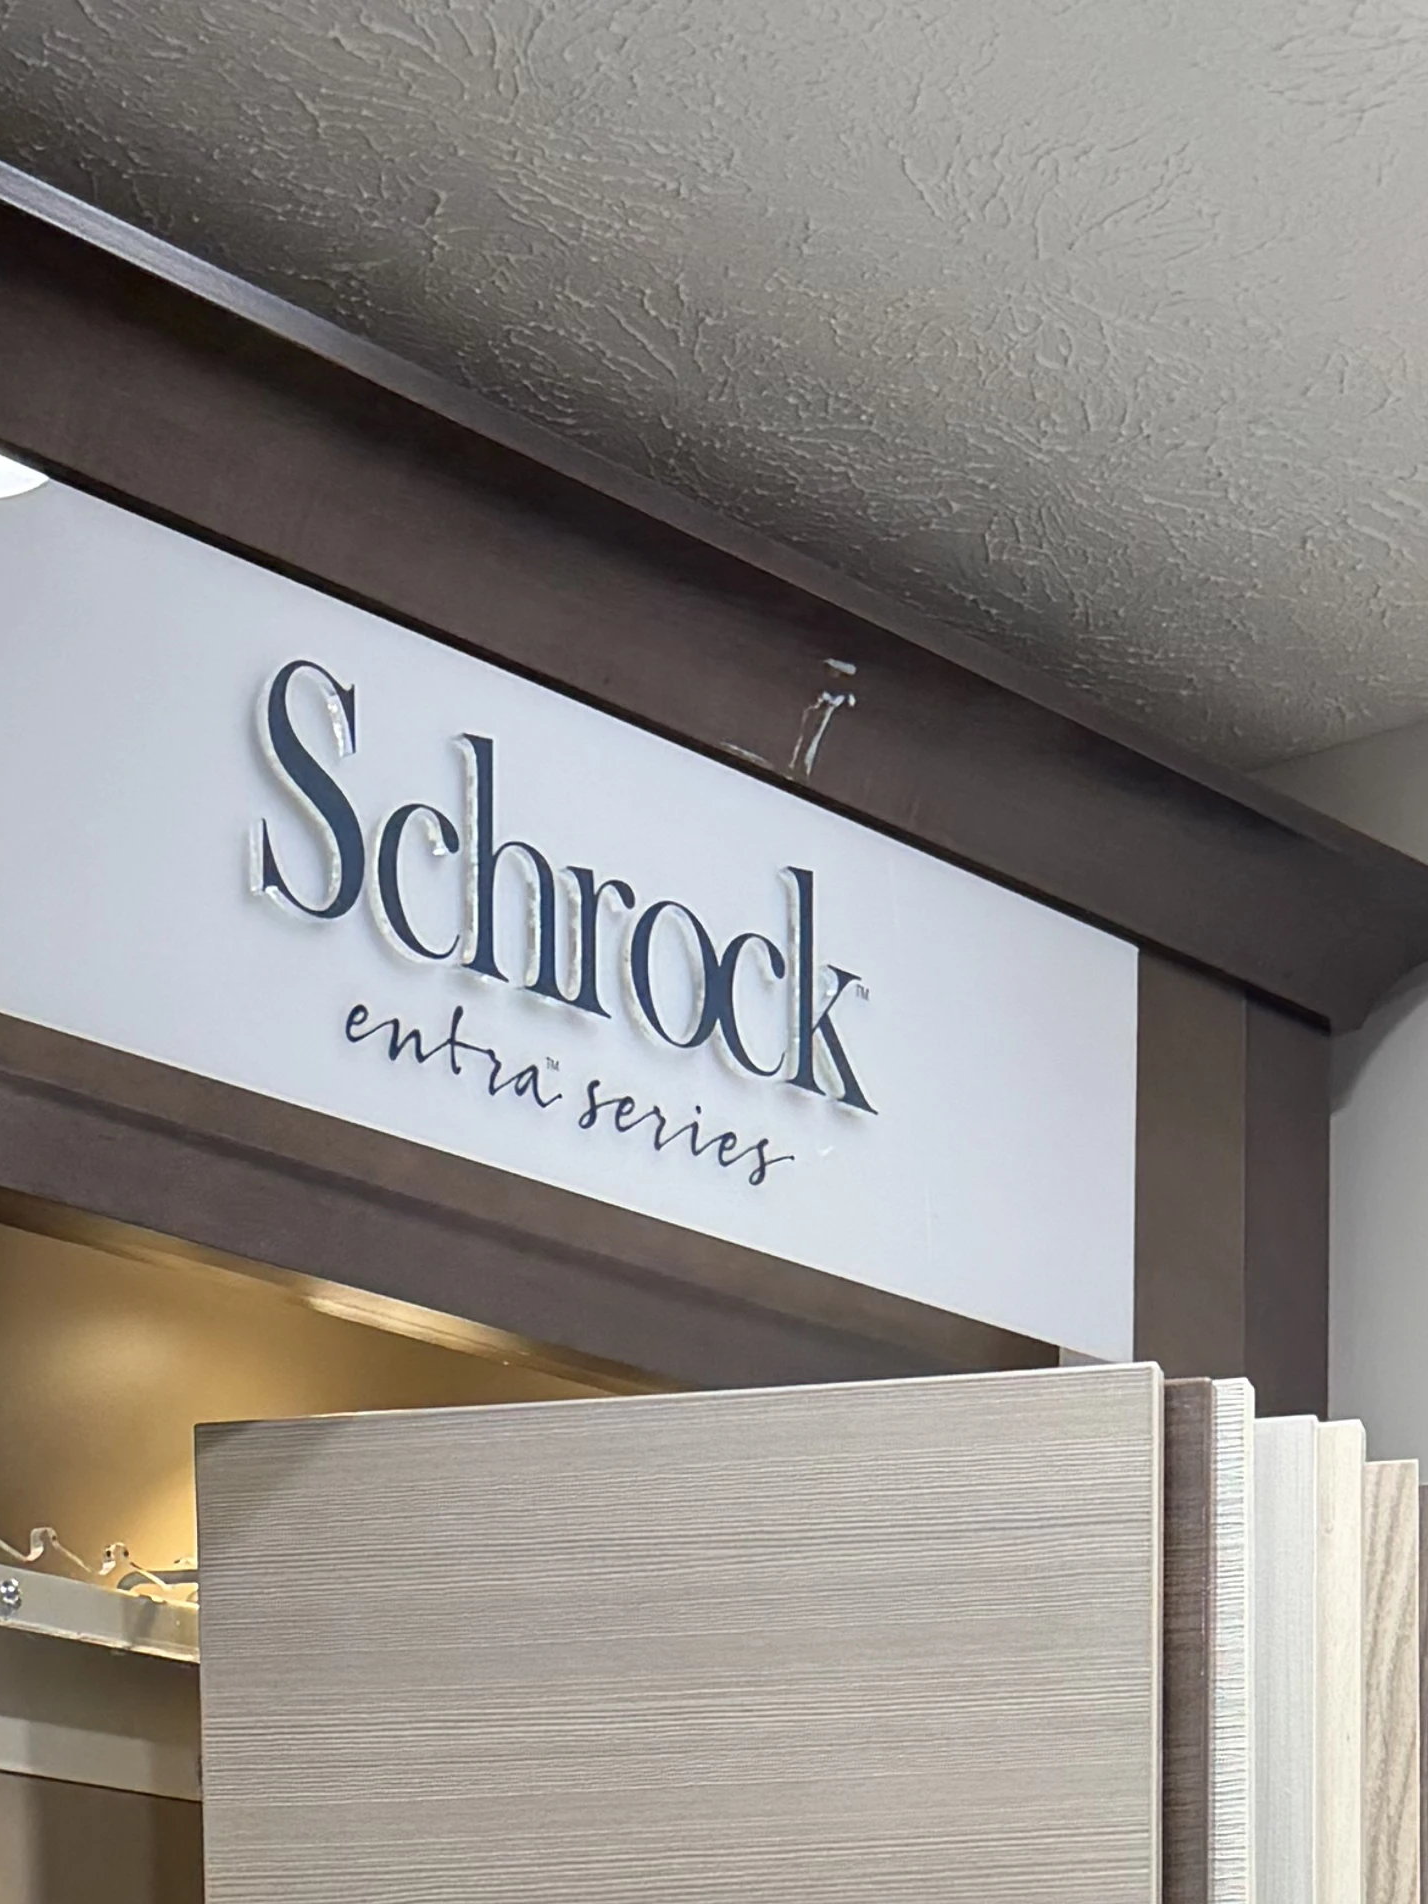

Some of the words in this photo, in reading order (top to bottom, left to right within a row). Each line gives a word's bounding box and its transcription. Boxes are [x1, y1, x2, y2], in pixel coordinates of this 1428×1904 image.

[254, 660, 878, 1116] Schrock
[345, 1004, 562, 1108] entra
[578, 1078, 794, 1186] series
